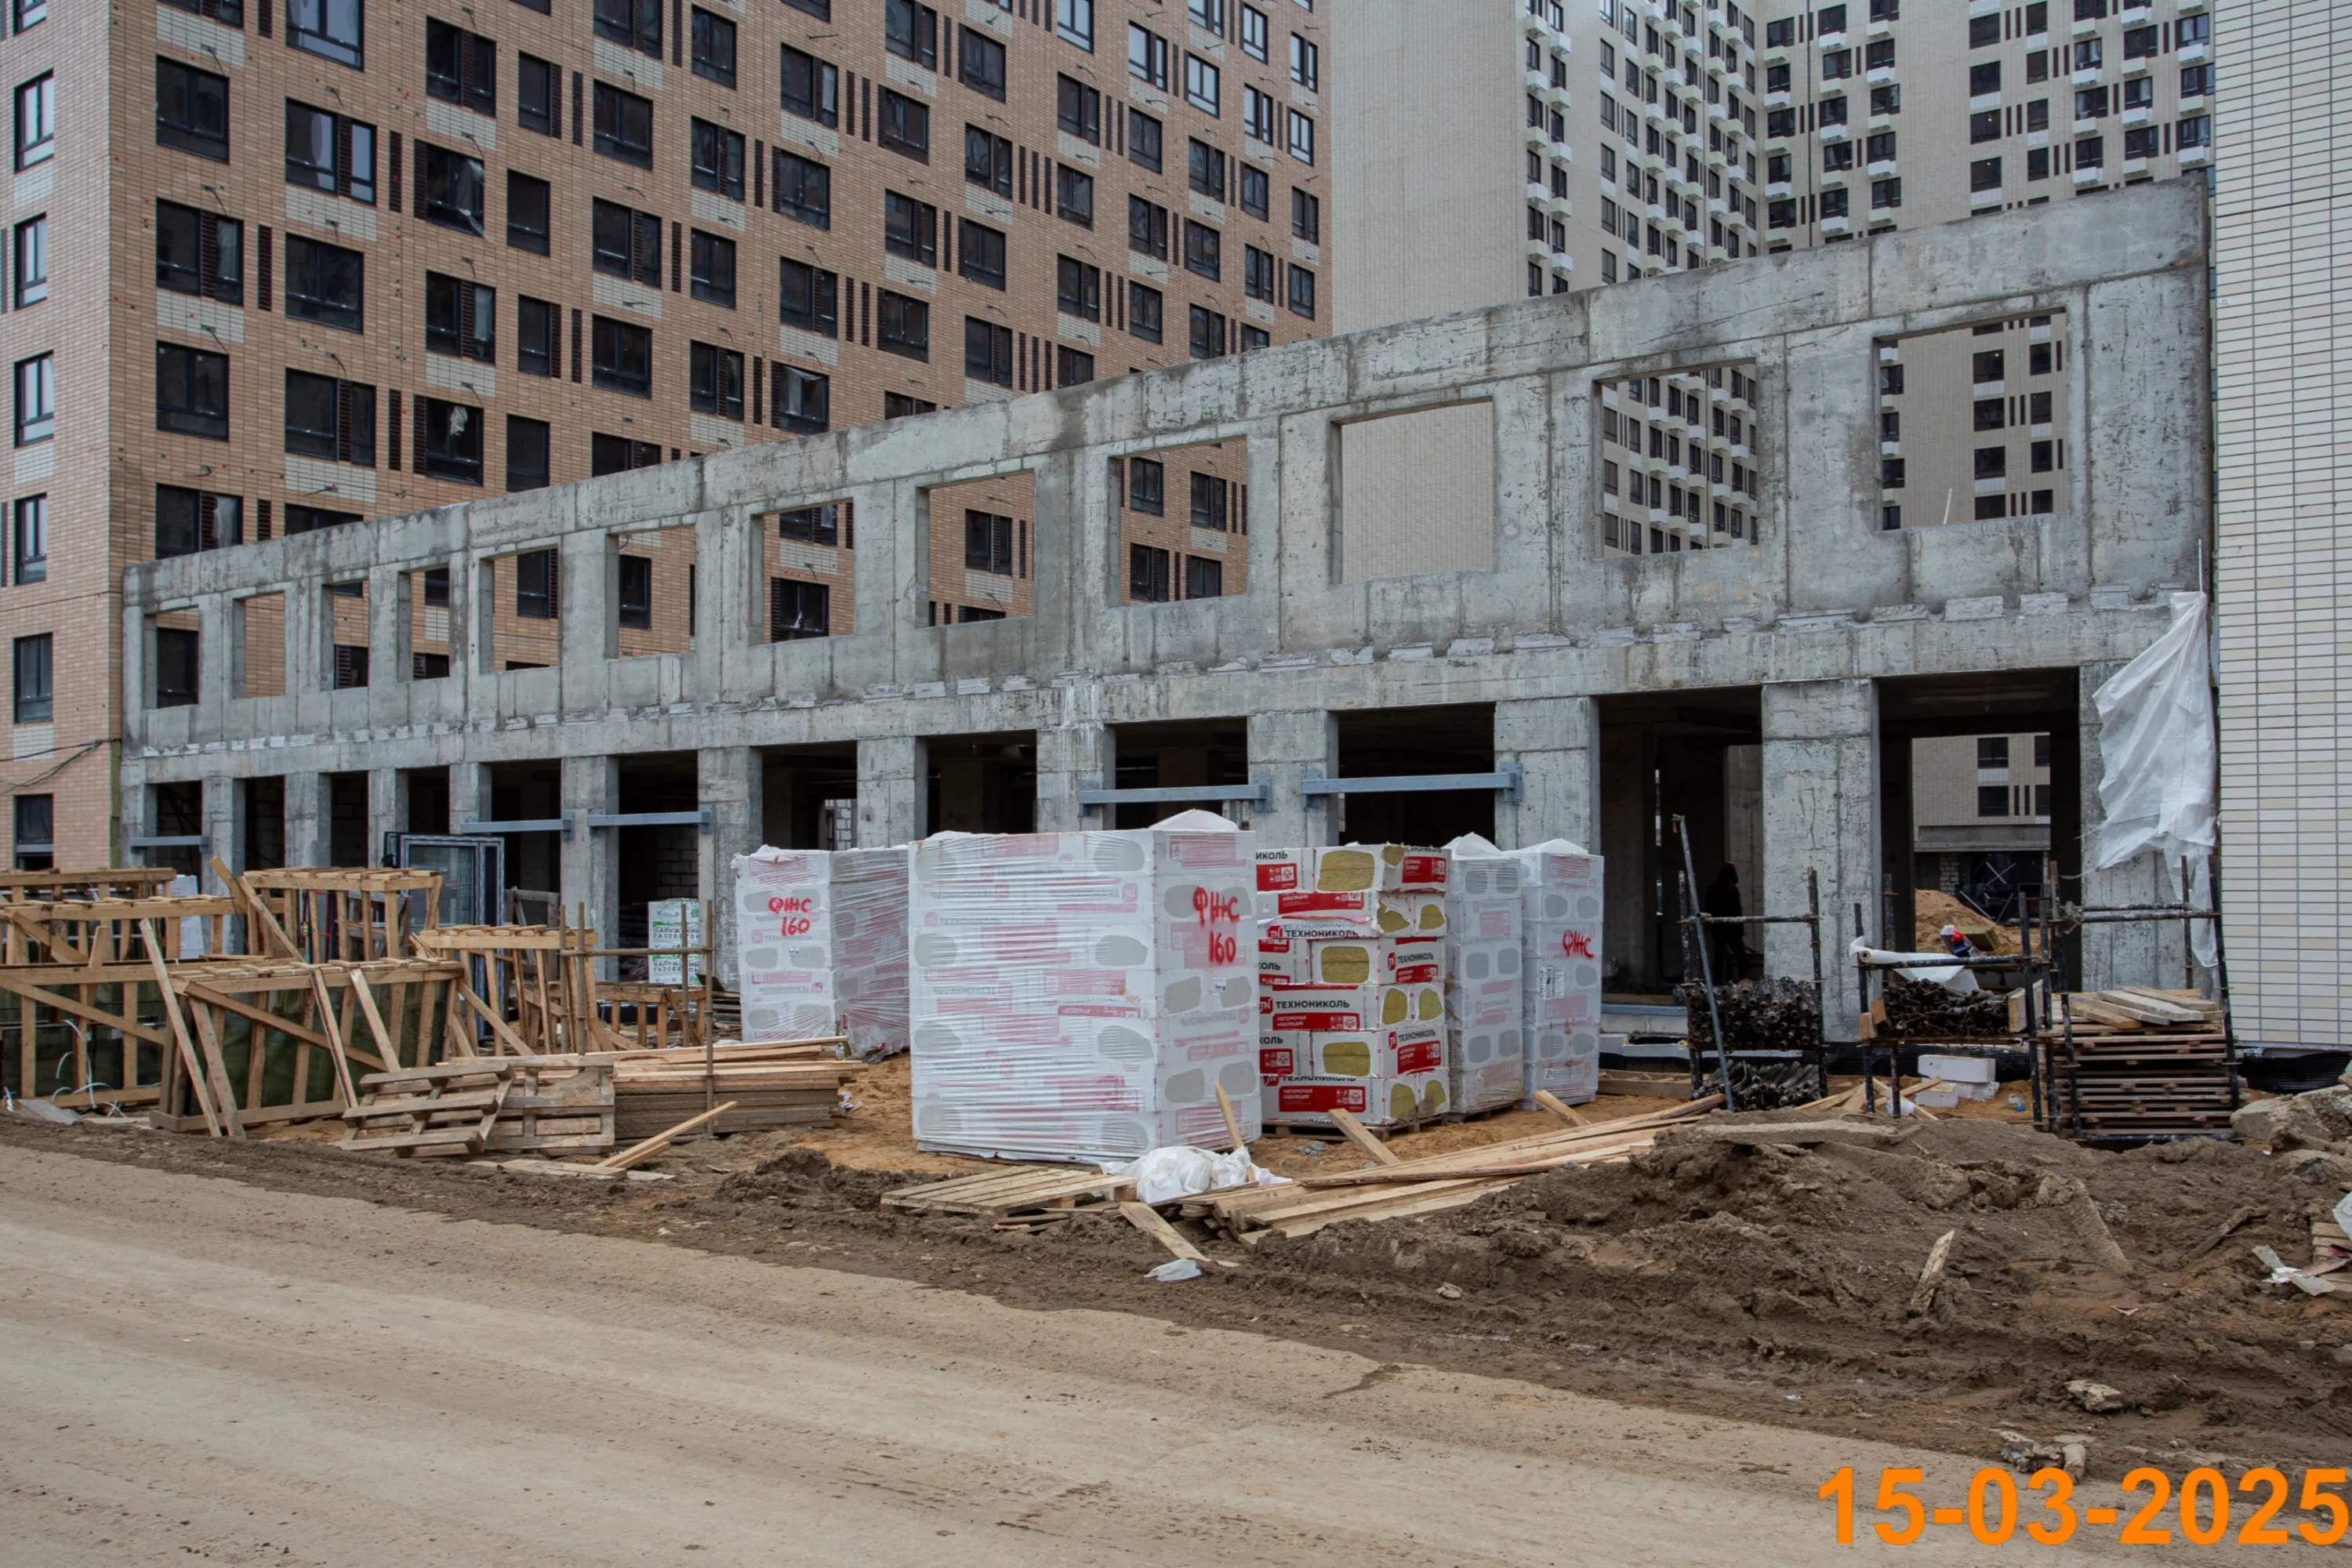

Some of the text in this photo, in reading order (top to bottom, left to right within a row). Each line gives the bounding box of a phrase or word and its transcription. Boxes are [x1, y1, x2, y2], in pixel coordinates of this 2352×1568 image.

[781, 916, 811, 938] 160
[1209, 929, 1236, 966] 160
[1275, 1000, 1350, 1009] ТЕХНОНИКОЛЬ
